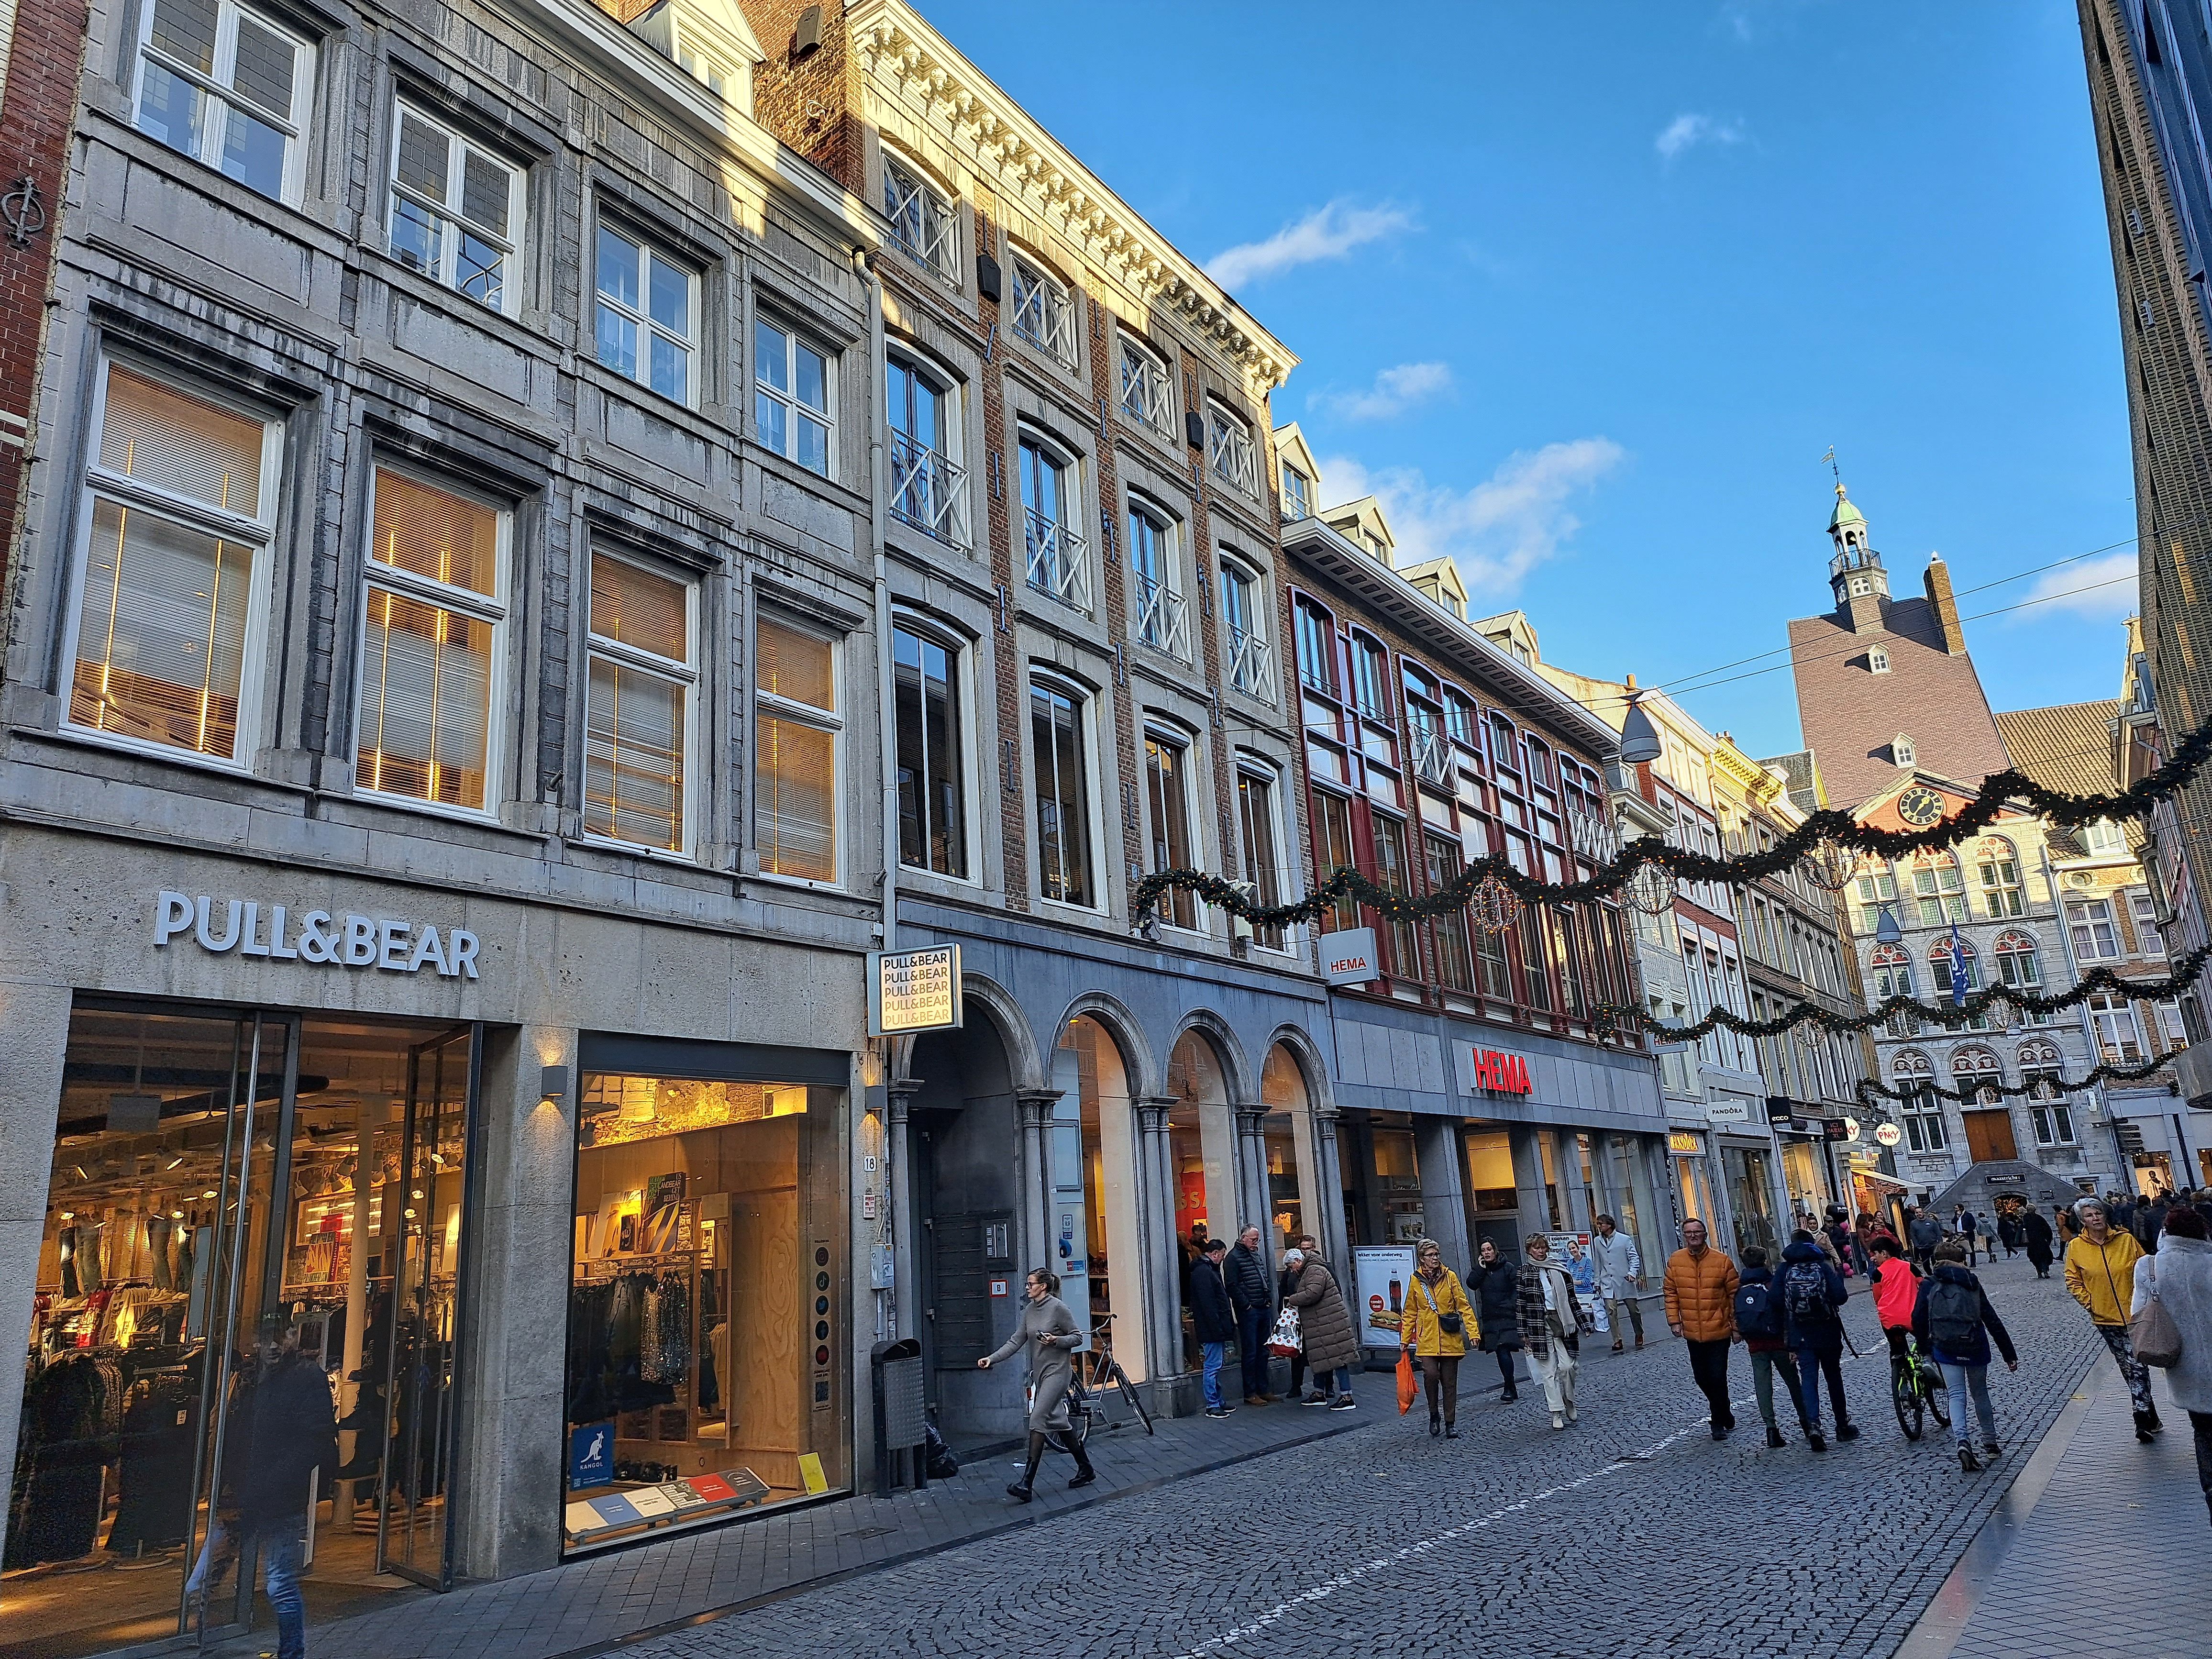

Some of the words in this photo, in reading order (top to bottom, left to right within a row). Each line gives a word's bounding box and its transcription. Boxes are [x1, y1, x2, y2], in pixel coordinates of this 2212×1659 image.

[154, 891, 479, 979] PULL&BEAR
[885, 953, 947, 970] PULL&BEAR
[1330, 957, 1367, 972] HEMA
[885, 967, 948, 984] PULL&BEAR
[885, 981, 948, 998] PULL&BEAR
[885, 995, 949, 1012] PULL&BEAR
[885, 1009, 949, 1026] PULL&BEAR
[1472, 1048, 1533, 1095] HEMA
[865, 1158, 874, 1170] 18
[579, 1461, 604, 1471] KANGOL
